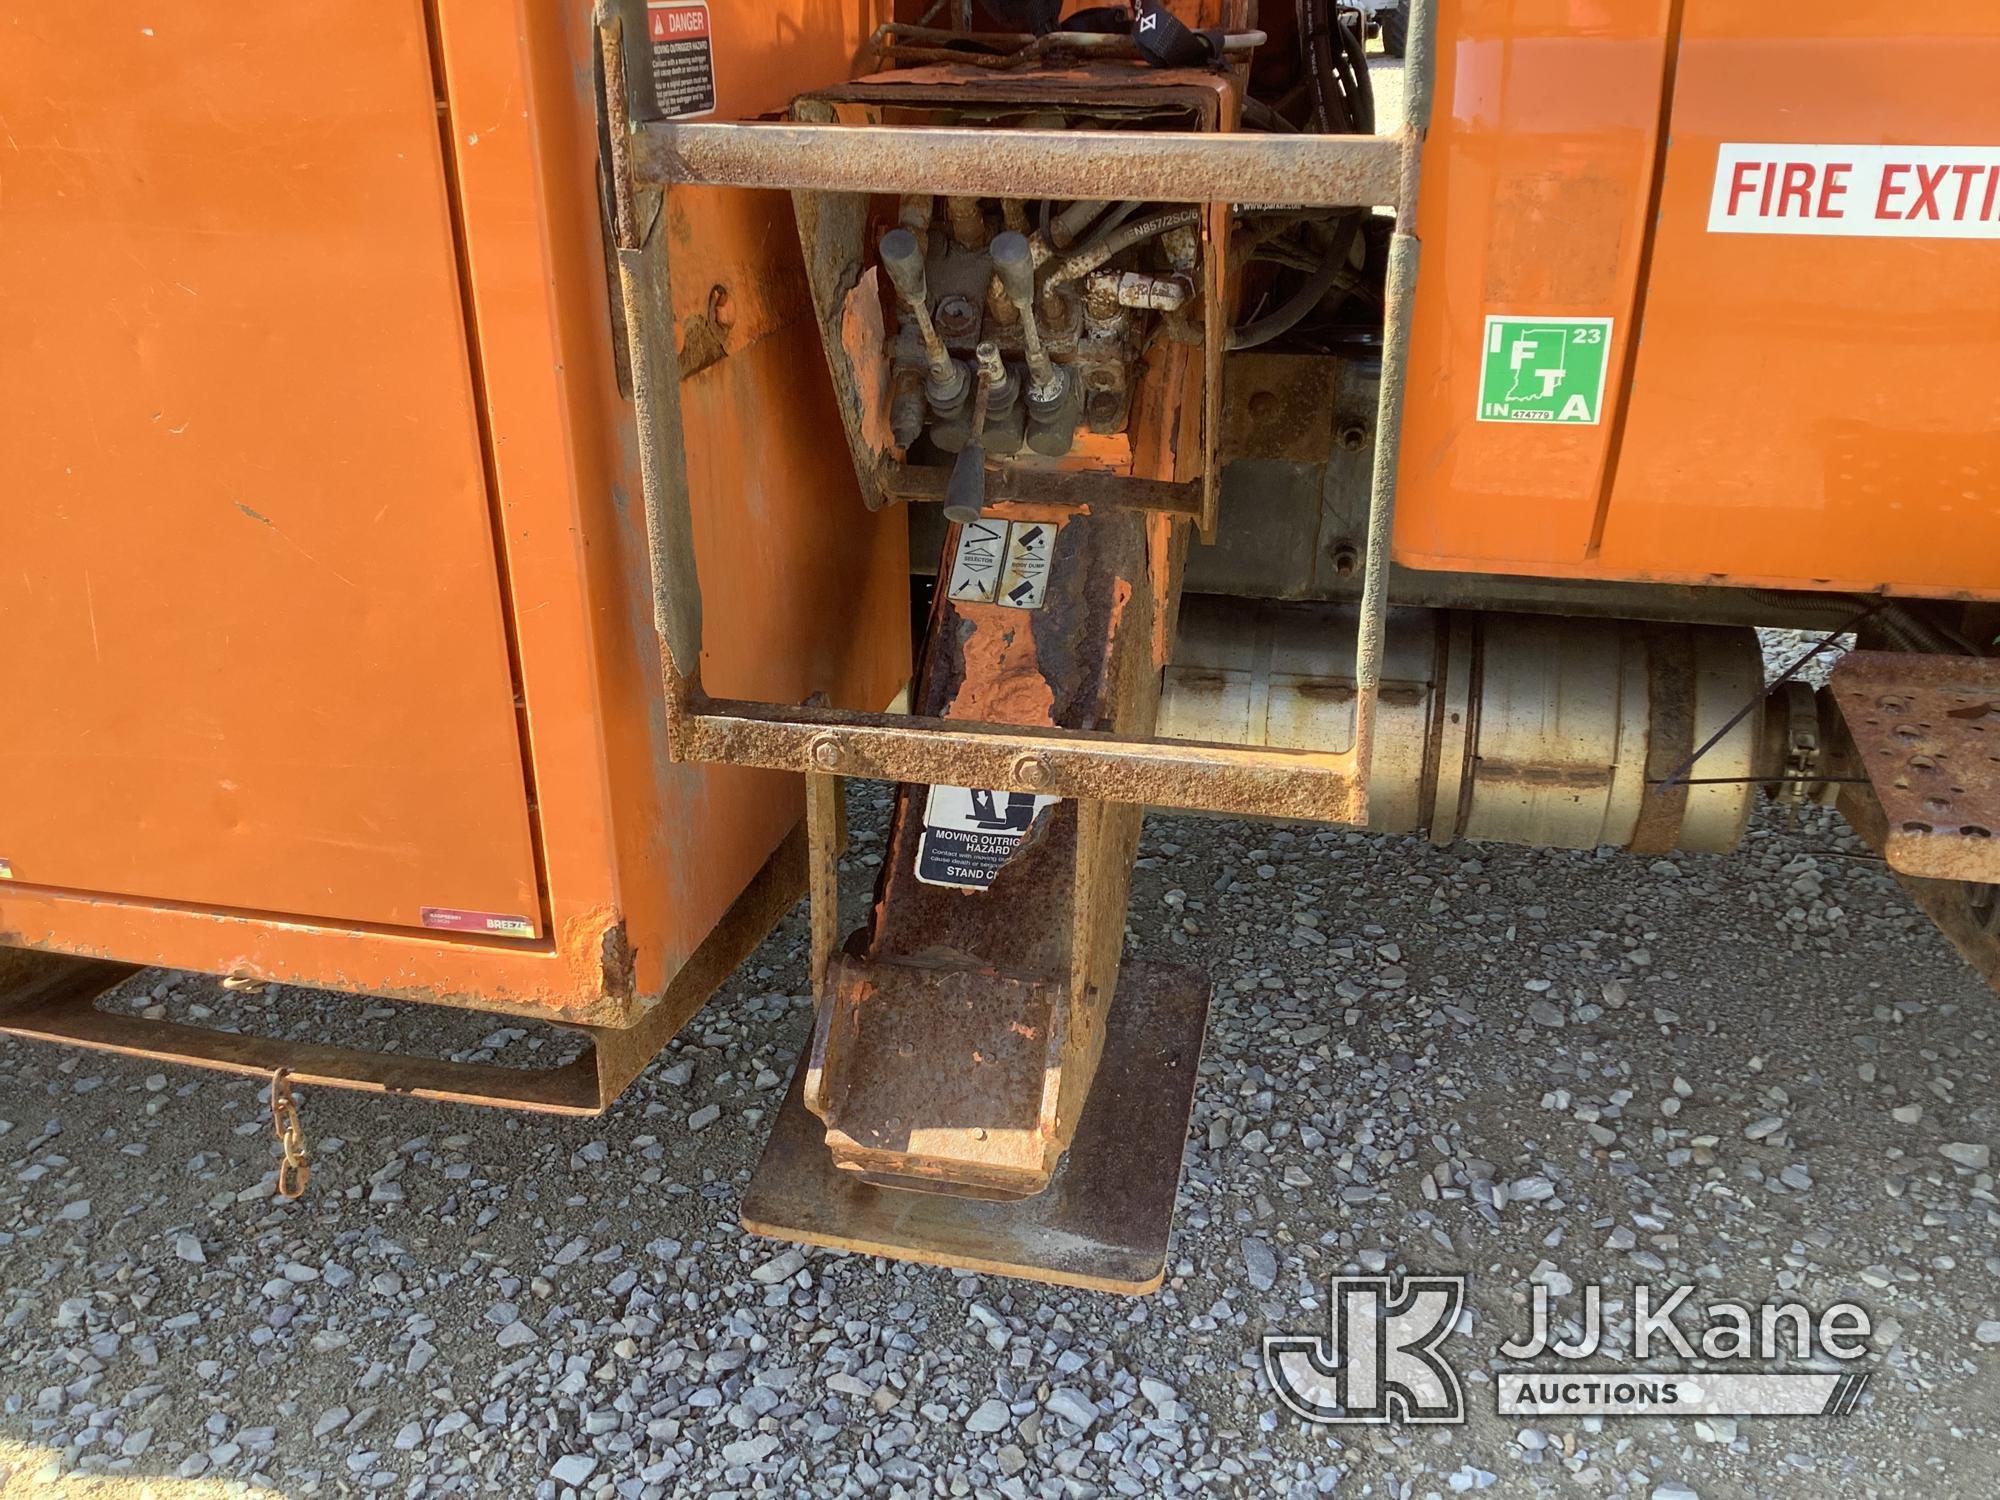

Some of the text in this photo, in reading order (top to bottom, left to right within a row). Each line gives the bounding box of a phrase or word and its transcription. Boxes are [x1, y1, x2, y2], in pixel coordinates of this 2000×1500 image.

[669, 12, 704, 33] DANGER
[1727, 162, 2000, 221] FIRE EXTI
[1572, 328, 1601, 344] 23
[1485, 402, 1550, 419] IN 474779
[935, 830, 978, 843] MOVING
[931, 848, 957, 857] Contact
[966, 843, 1010, 855] HAZARD
[946, 865, 984, 879] STAND
[486, 919, 527, 930] BREEZE
